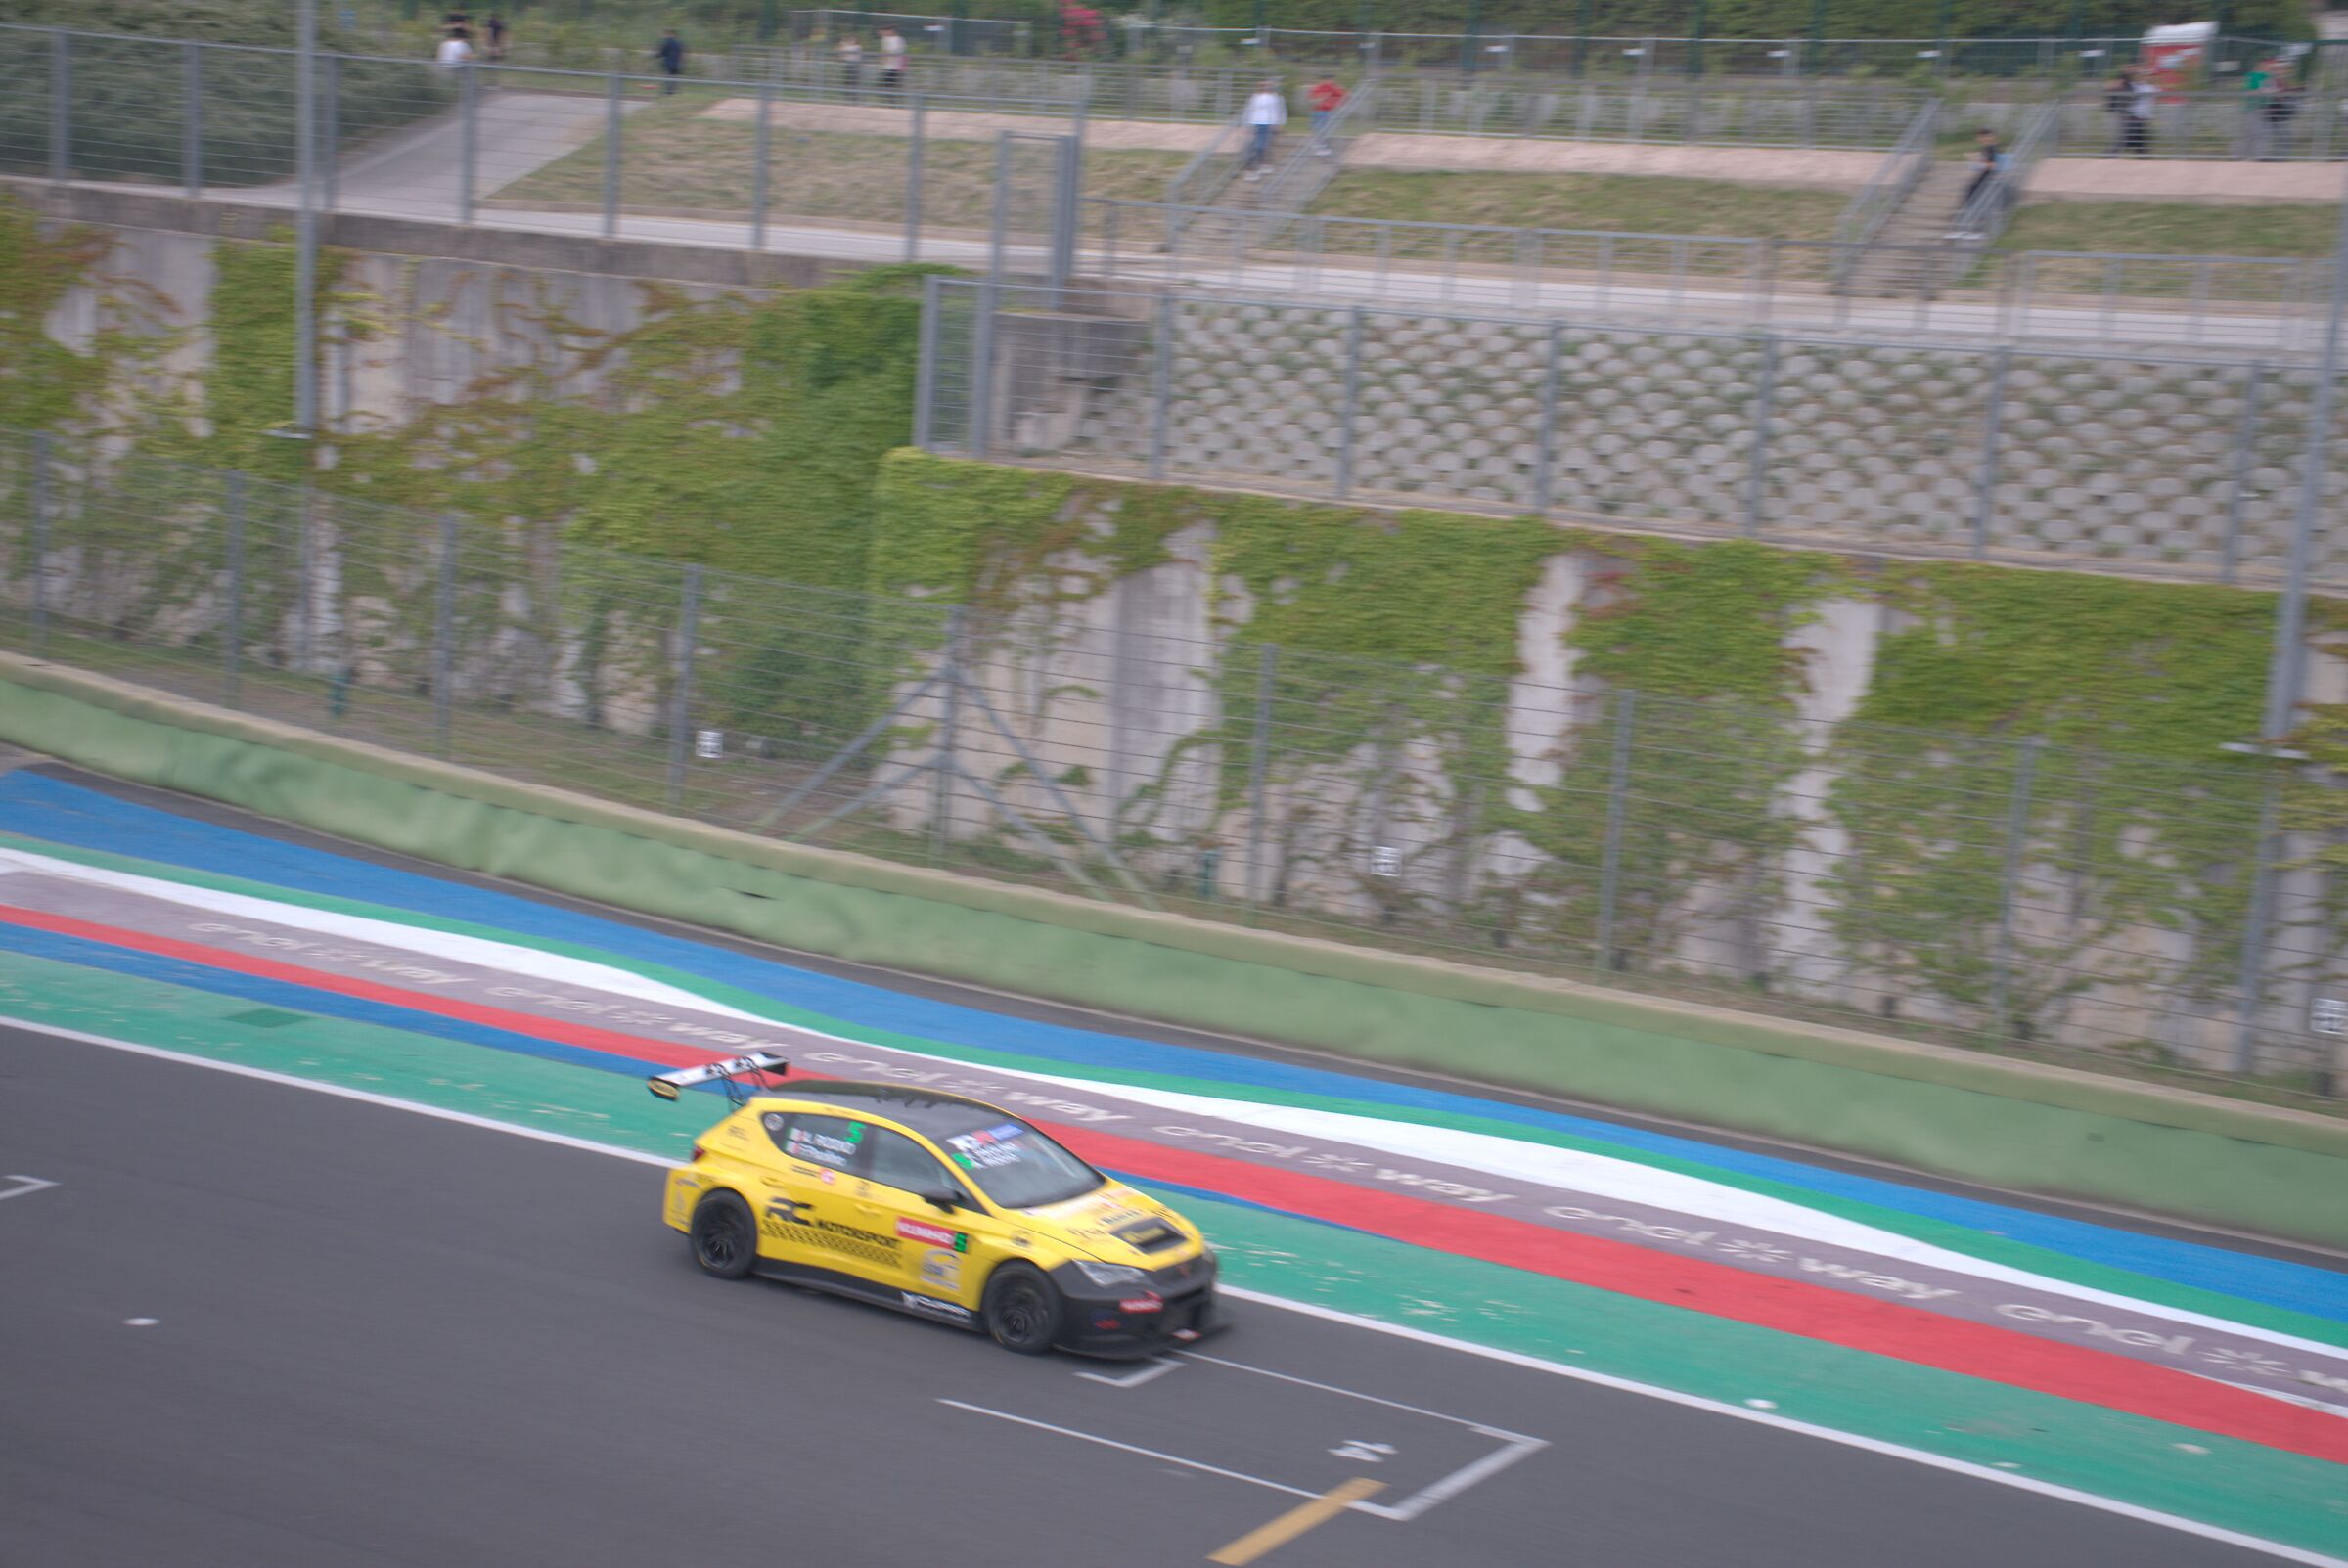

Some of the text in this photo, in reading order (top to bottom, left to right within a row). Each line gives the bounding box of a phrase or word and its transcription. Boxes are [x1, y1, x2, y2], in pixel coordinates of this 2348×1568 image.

[1152, 1125, 1518, 1202] enel way
[1543, 1206, 1961, 1300] enel way
[1994, 1303, 2197, 1355] enel
